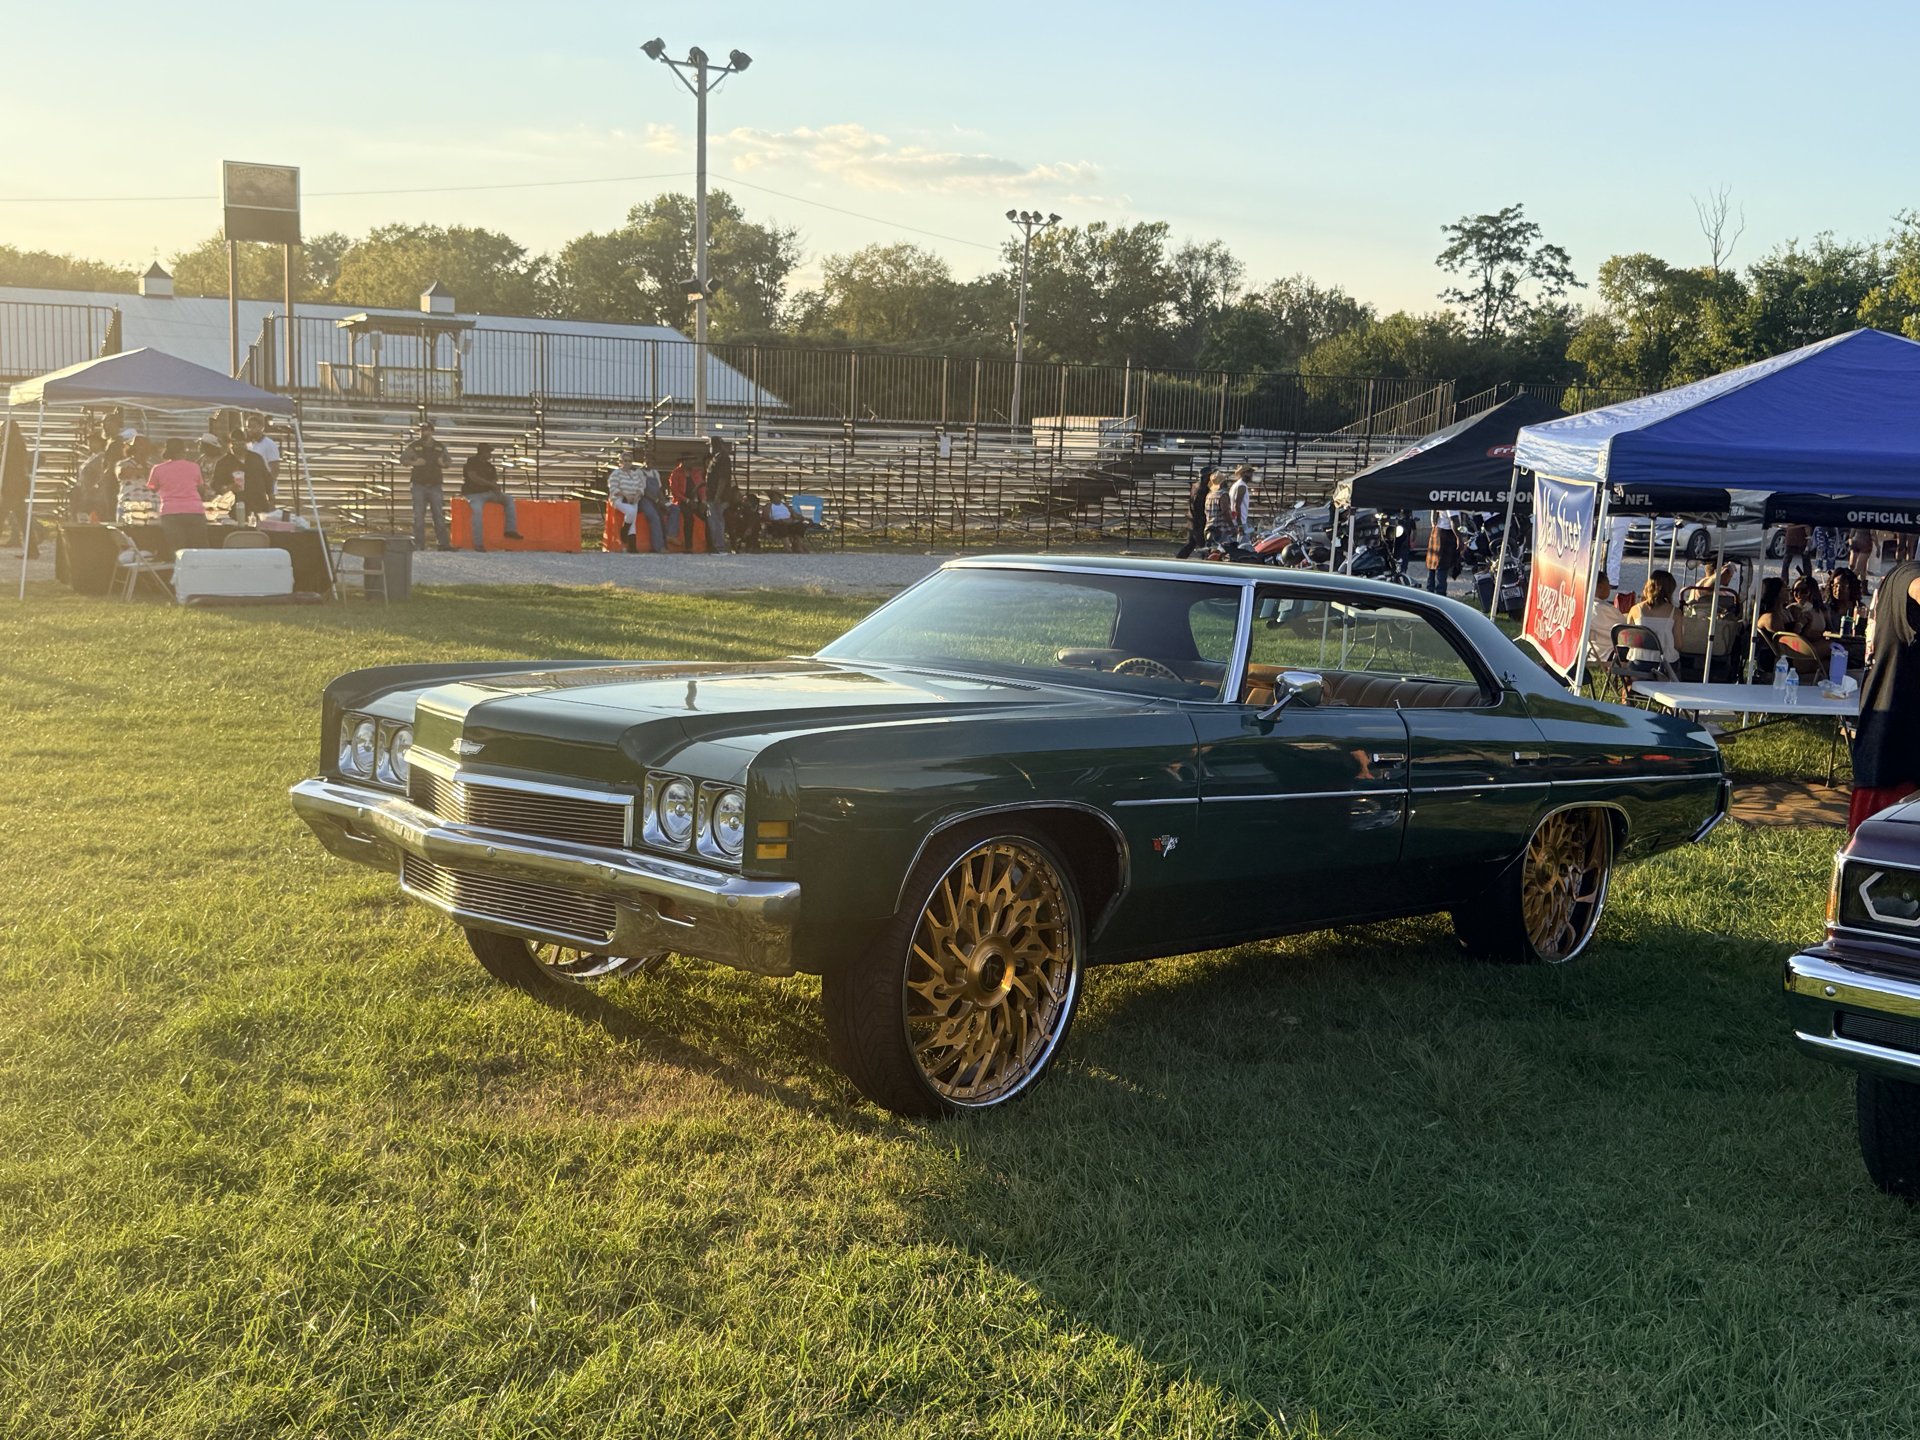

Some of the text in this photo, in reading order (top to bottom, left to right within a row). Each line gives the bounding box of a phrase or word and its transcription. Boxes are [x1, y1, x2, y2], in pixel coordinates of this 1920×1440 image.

[1428, 490, 1493, 503] OFFICIAL
[1625, 493, 1652, 505] NFL
[1847, 511, 1912, 525] OFFICIAL
